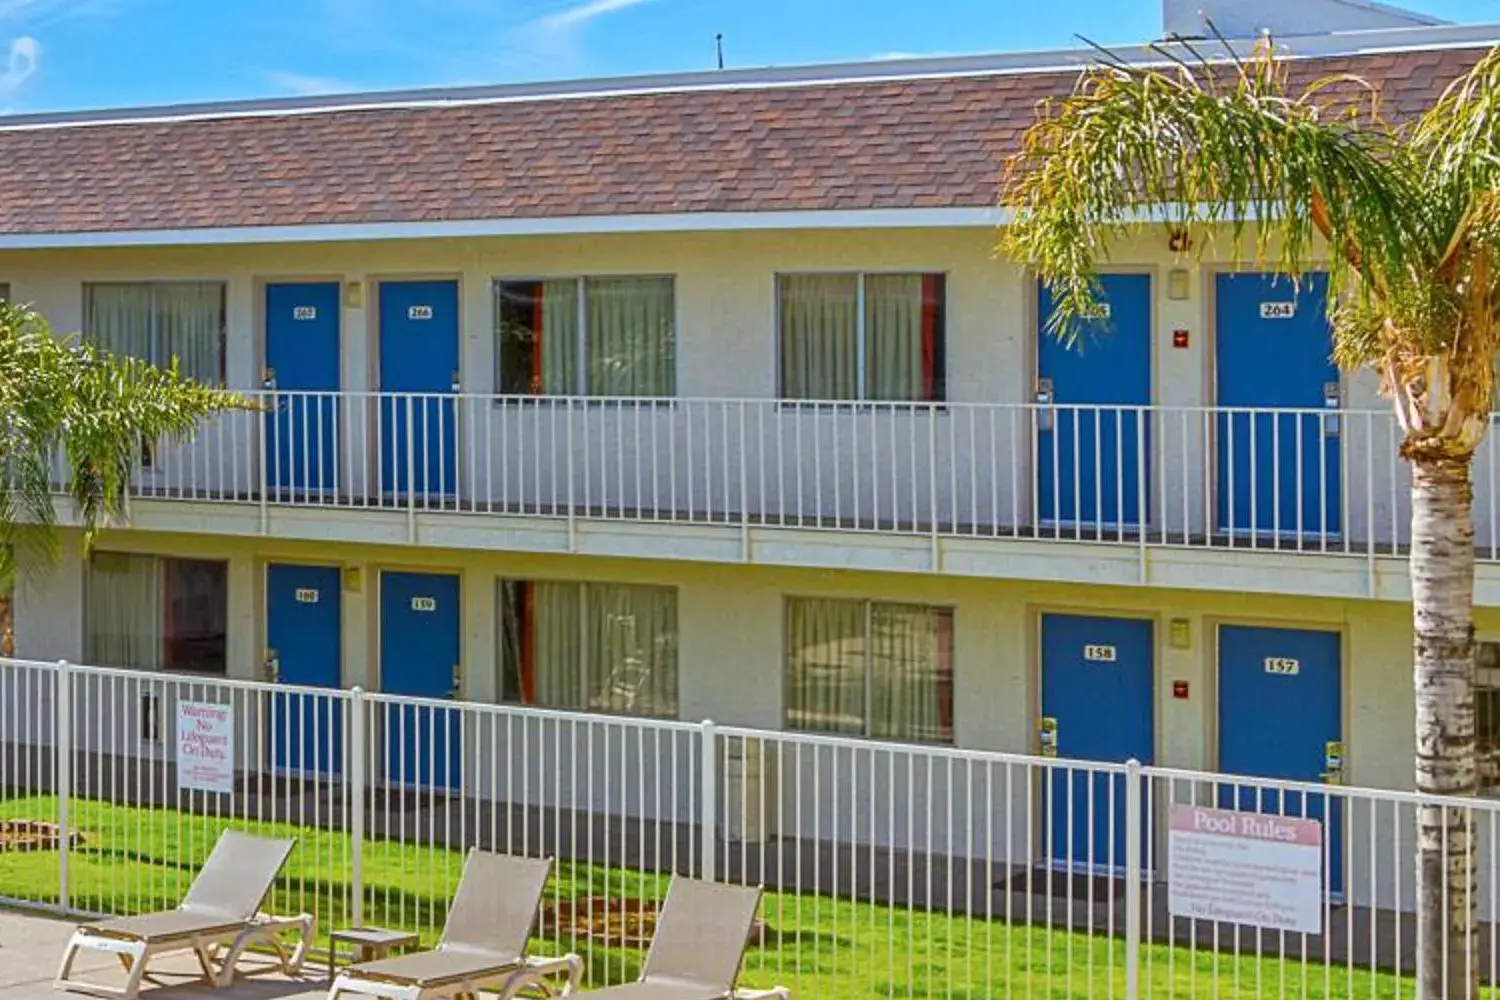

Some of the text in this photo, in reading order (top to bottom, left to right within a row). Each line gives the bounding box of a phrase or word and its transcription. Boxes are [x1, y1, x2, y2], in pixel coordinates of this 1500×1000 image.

[1264, 303, 1292, 316] 264
[1088, 646, 1113, 659] 158
[1268, 660, 1294, 673] 157
[196, 719, 213, 732] No
[1193, 810, 1298, 841] Pool Rules
